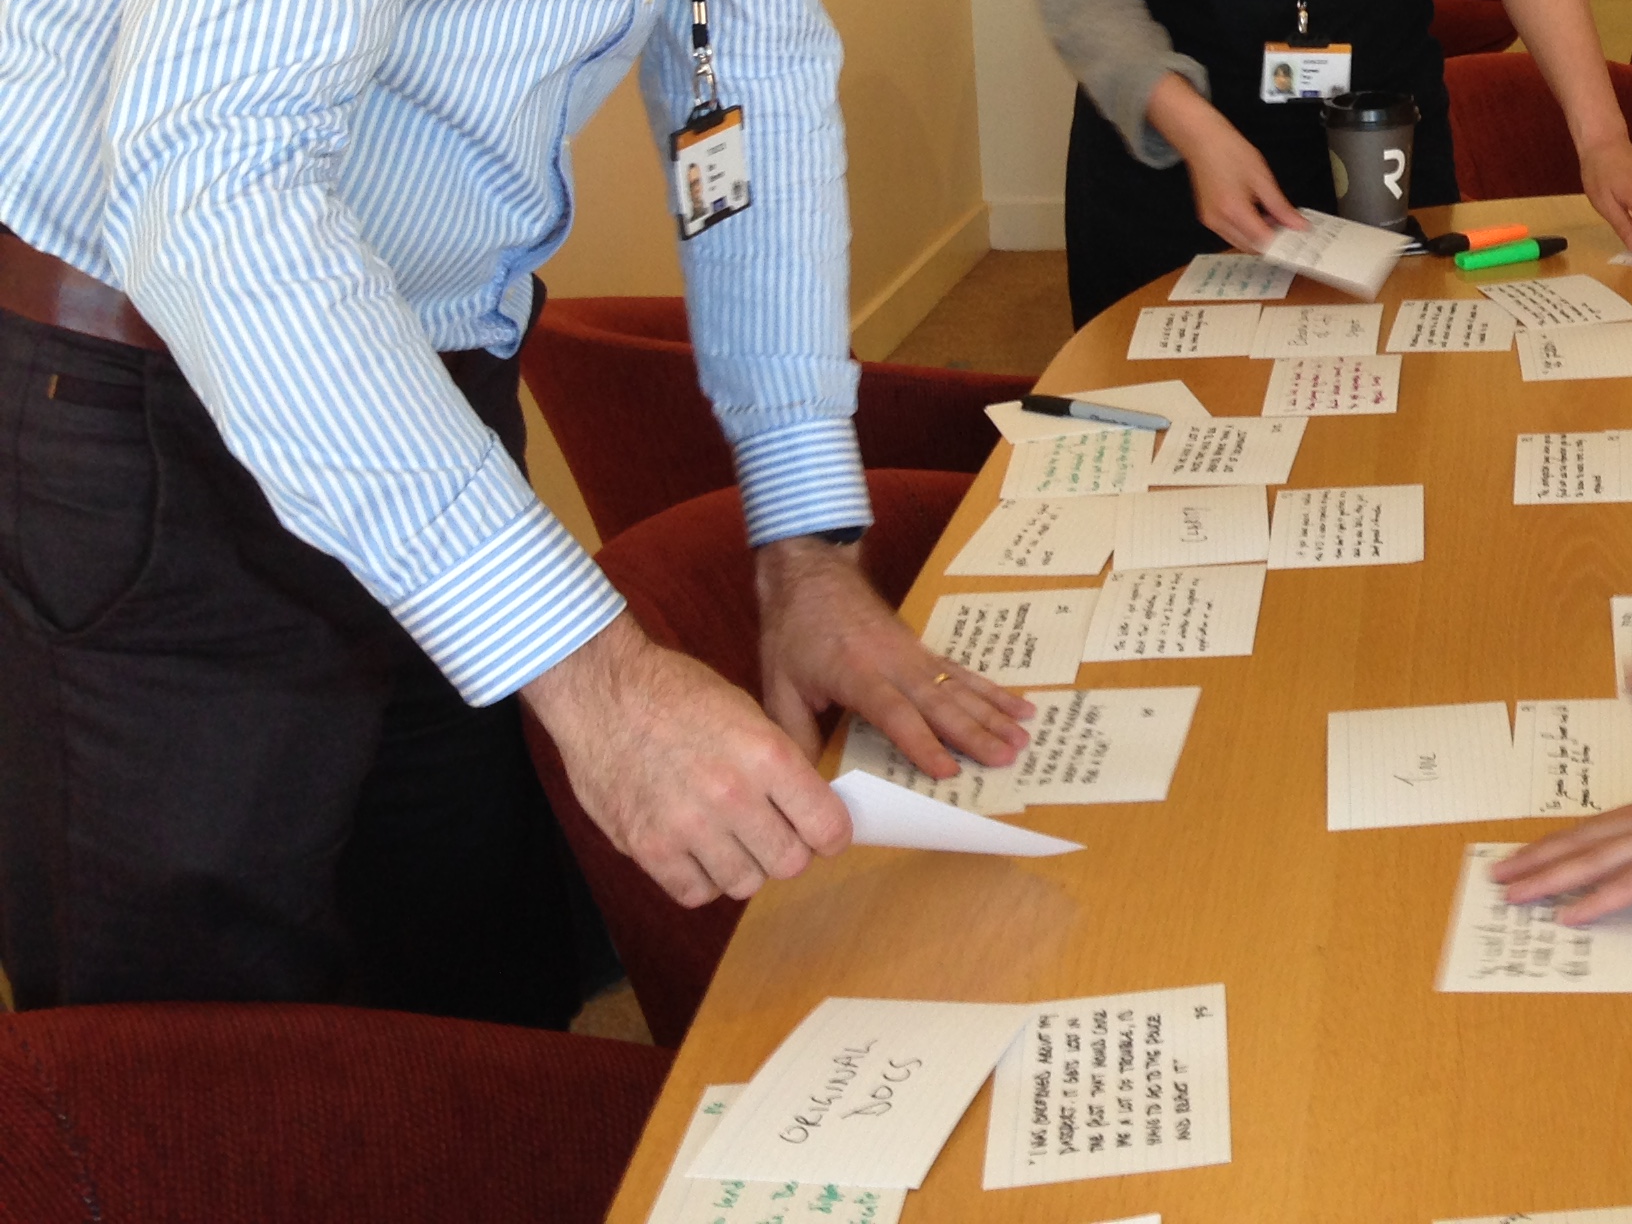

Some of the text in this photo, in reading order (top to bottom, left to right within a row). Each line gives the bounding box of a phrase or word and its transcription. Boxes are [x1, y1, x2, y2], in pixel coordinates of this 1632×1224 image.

[1383, 149, 1406, 200] R
[1038, 1014, 1059, 1029] MY
[1037, 1031, 1053, 1065] ABOUT
[1144, 1049, 1161, 1069] THE
[780, 1039, 878, 1145] ORIGINAL
[841, 1057, 923, 1121] DOCS
[1117, 1078, 1133, 1092] OF
[1145, 1083, 1162, 1099] GO
[1116, 1097, 1133, 1113] LOT
[1175, 1117, 1191, 1141] AND
[1088, 1133, 1104, 1153] THE
[1116, 1132, 1132, 1148] ME
